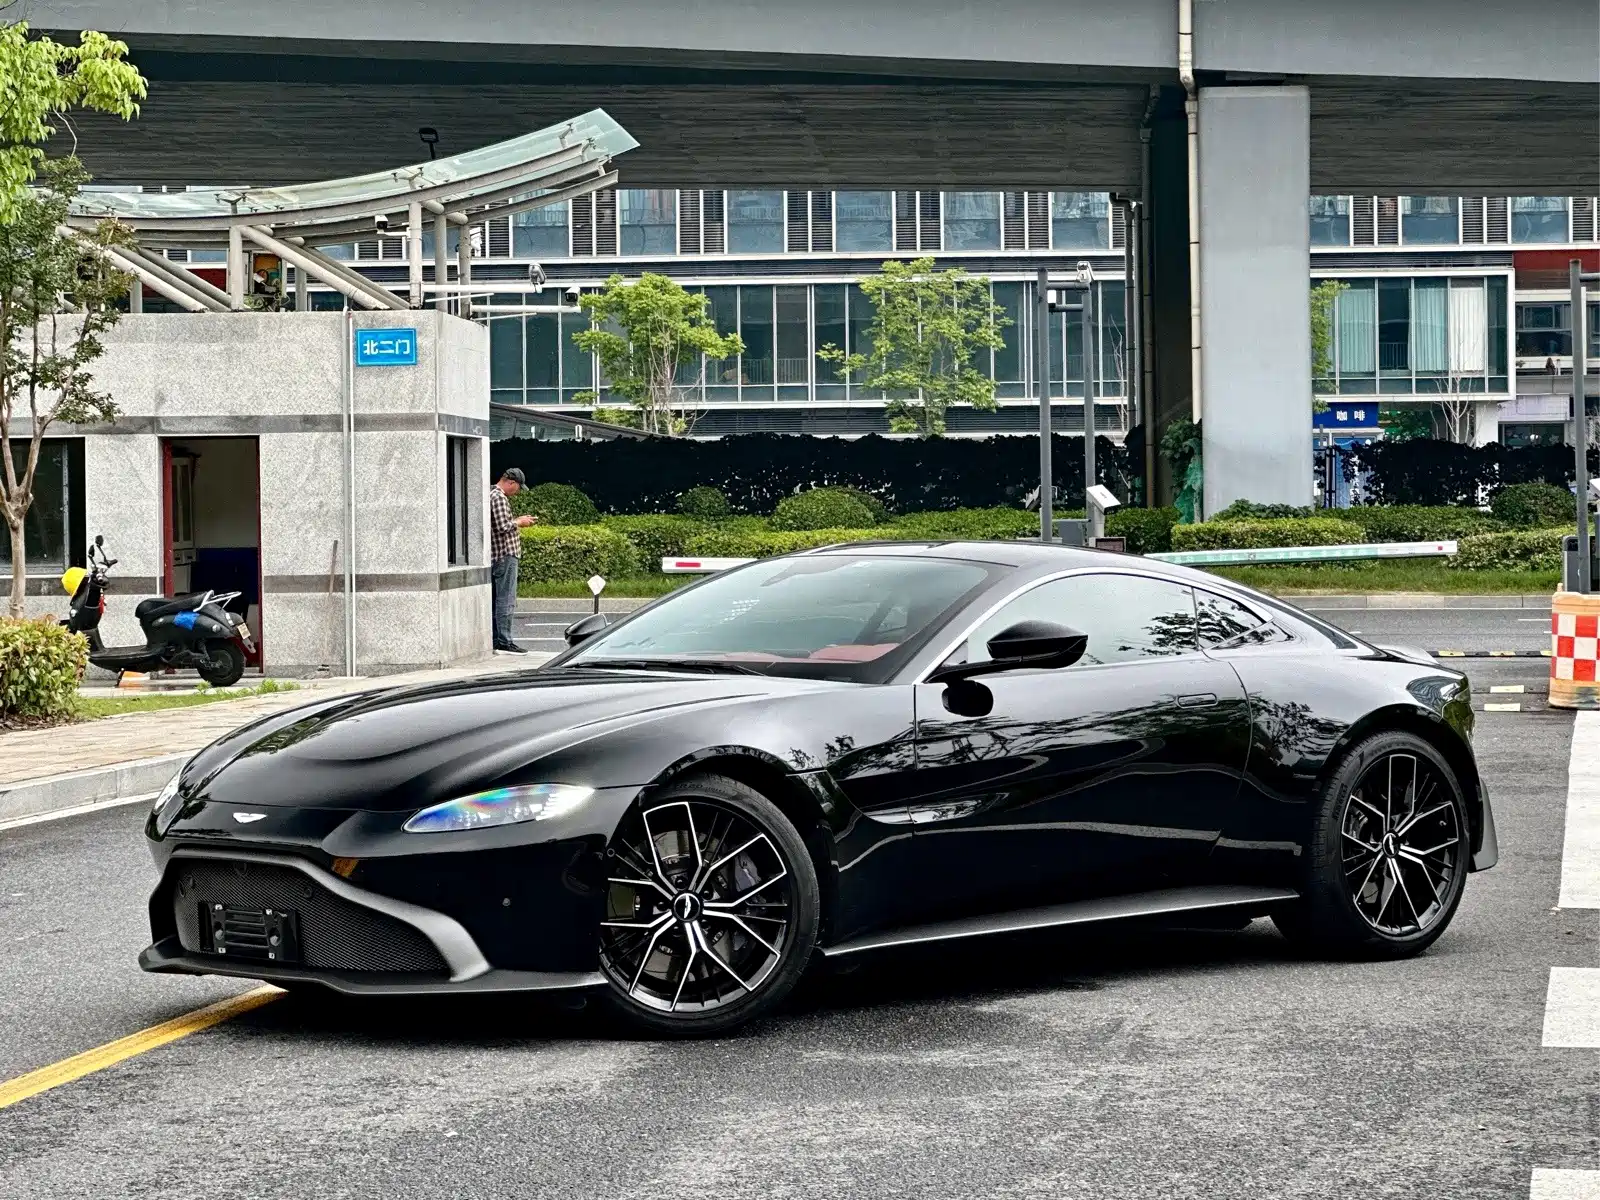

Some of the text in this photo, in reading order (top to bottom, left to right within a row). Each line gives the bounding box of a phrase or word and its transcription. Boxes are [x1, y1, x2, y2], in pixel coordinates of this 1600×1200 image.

[363, 339, 410, 355] 北二门
[1336, 410, 1366, 421] 咖啡
